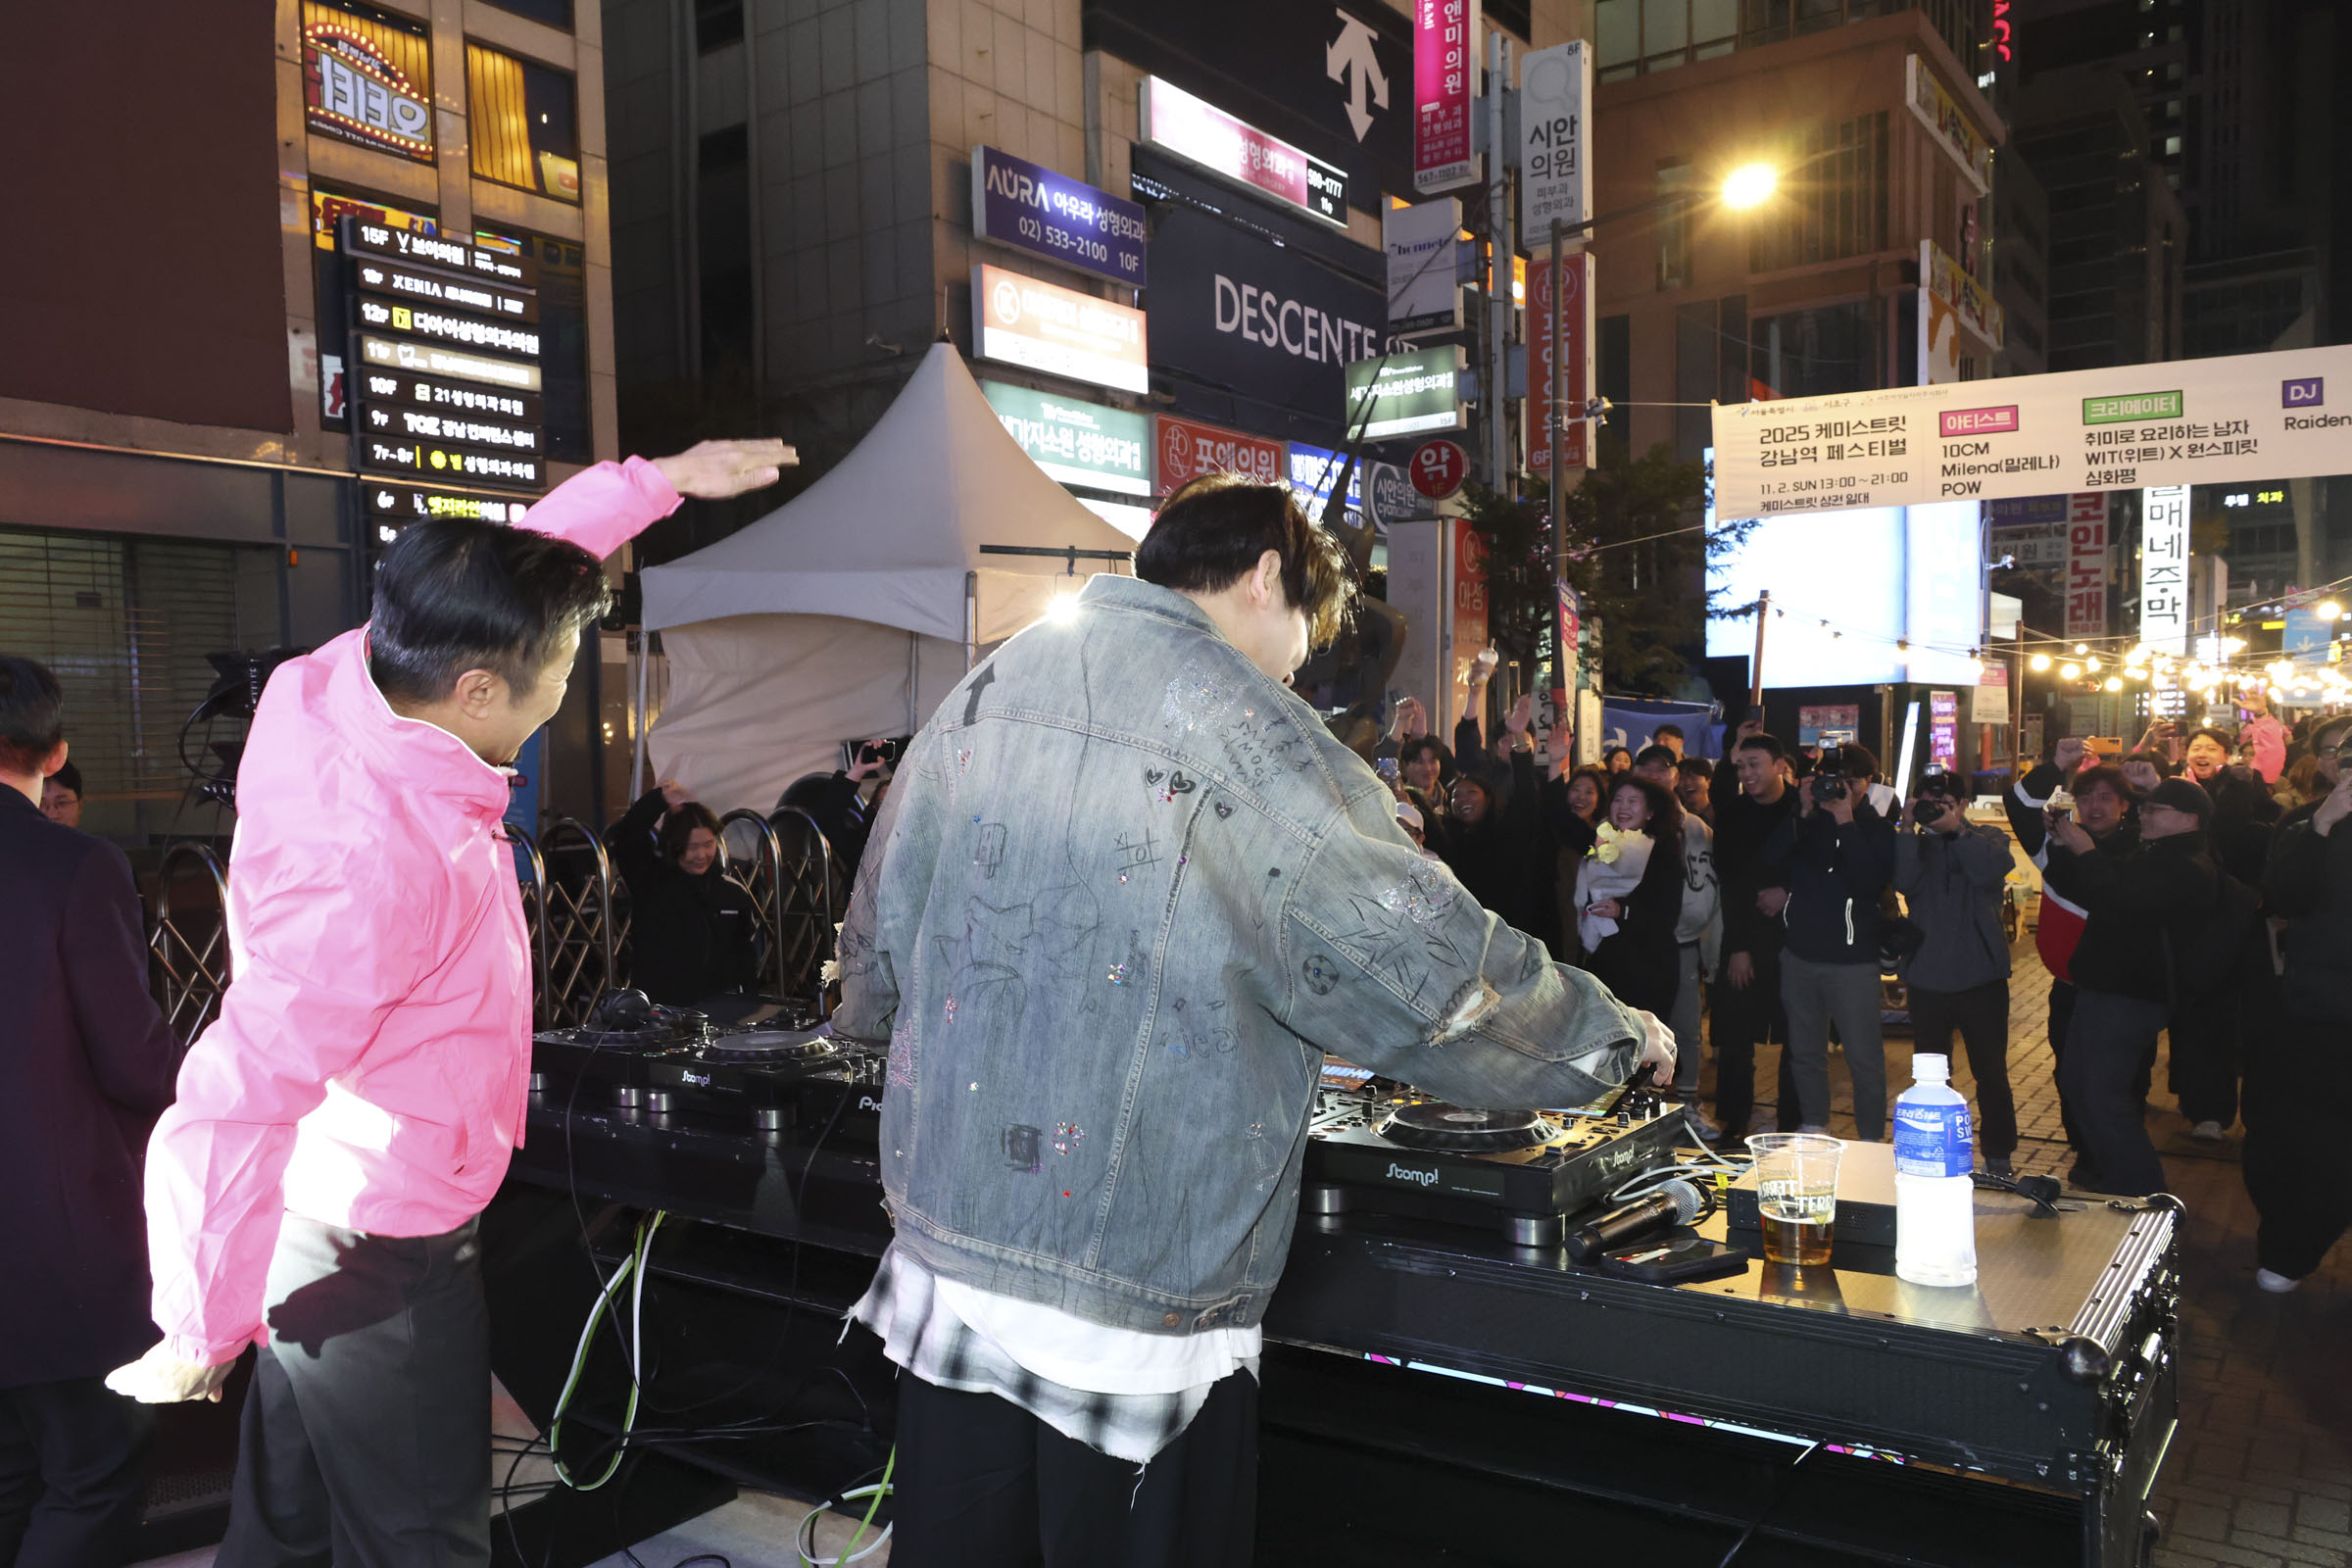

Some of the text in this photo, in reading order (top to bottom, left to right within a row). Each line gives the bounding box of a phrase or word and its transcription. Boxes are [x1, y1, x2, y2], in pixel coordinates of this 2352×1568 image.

[1568, 43, 1581, 56] 8F
[1529, 115, 1578, 149] 시안
[1530, 148, 1575, 179] 의원
[987, 165, 1145, 244] AURA 아우라 성형외과
[1019, 217, 1139, 272] 02) 533-2100 10F
[362, 303, 389, 323] 12F
[1215, 273, 1376, 368] DESCENTE
[2289, 383, 2317, 401] DJ
[2090, 396, 2177, 417] 크리에이터
[370, 410, 388, 426] 9F
[1946, 411, 2012, 430] 아티스트
[2284, 413, 2352, 430] Raiden
[1760, 416, 1906, 445] 2025 케미스트릿
[2085, 419, 2249, 446] 취미로 요리하는 남자
[1760, 438, 1907, 467] 강남역 페스티벌
[1942, 442, 1989, 459] 10CM
[2085, 439, 2258, 466] WIT(위트) X 원스피릿
[1420, 446, 1451, 478] 약
[1941, 455, 2060, 477] Milena(밀레나)
[1792, 480, 1817, 492] SUN
[1820, 476, 1856, 490] 13:00
[1871, 471, 1908, 485] 21:00
[2085, 467, 2136, 486] 심화평
[1377, 477, 1415, 508] 시안의원
[1941, 480, 1982, 496] POW
[376, 491, 395, 509] 6F
[1760, 496, 1817, 512] 케미스트릿
[1845, 492, 1869, 506] 일대
